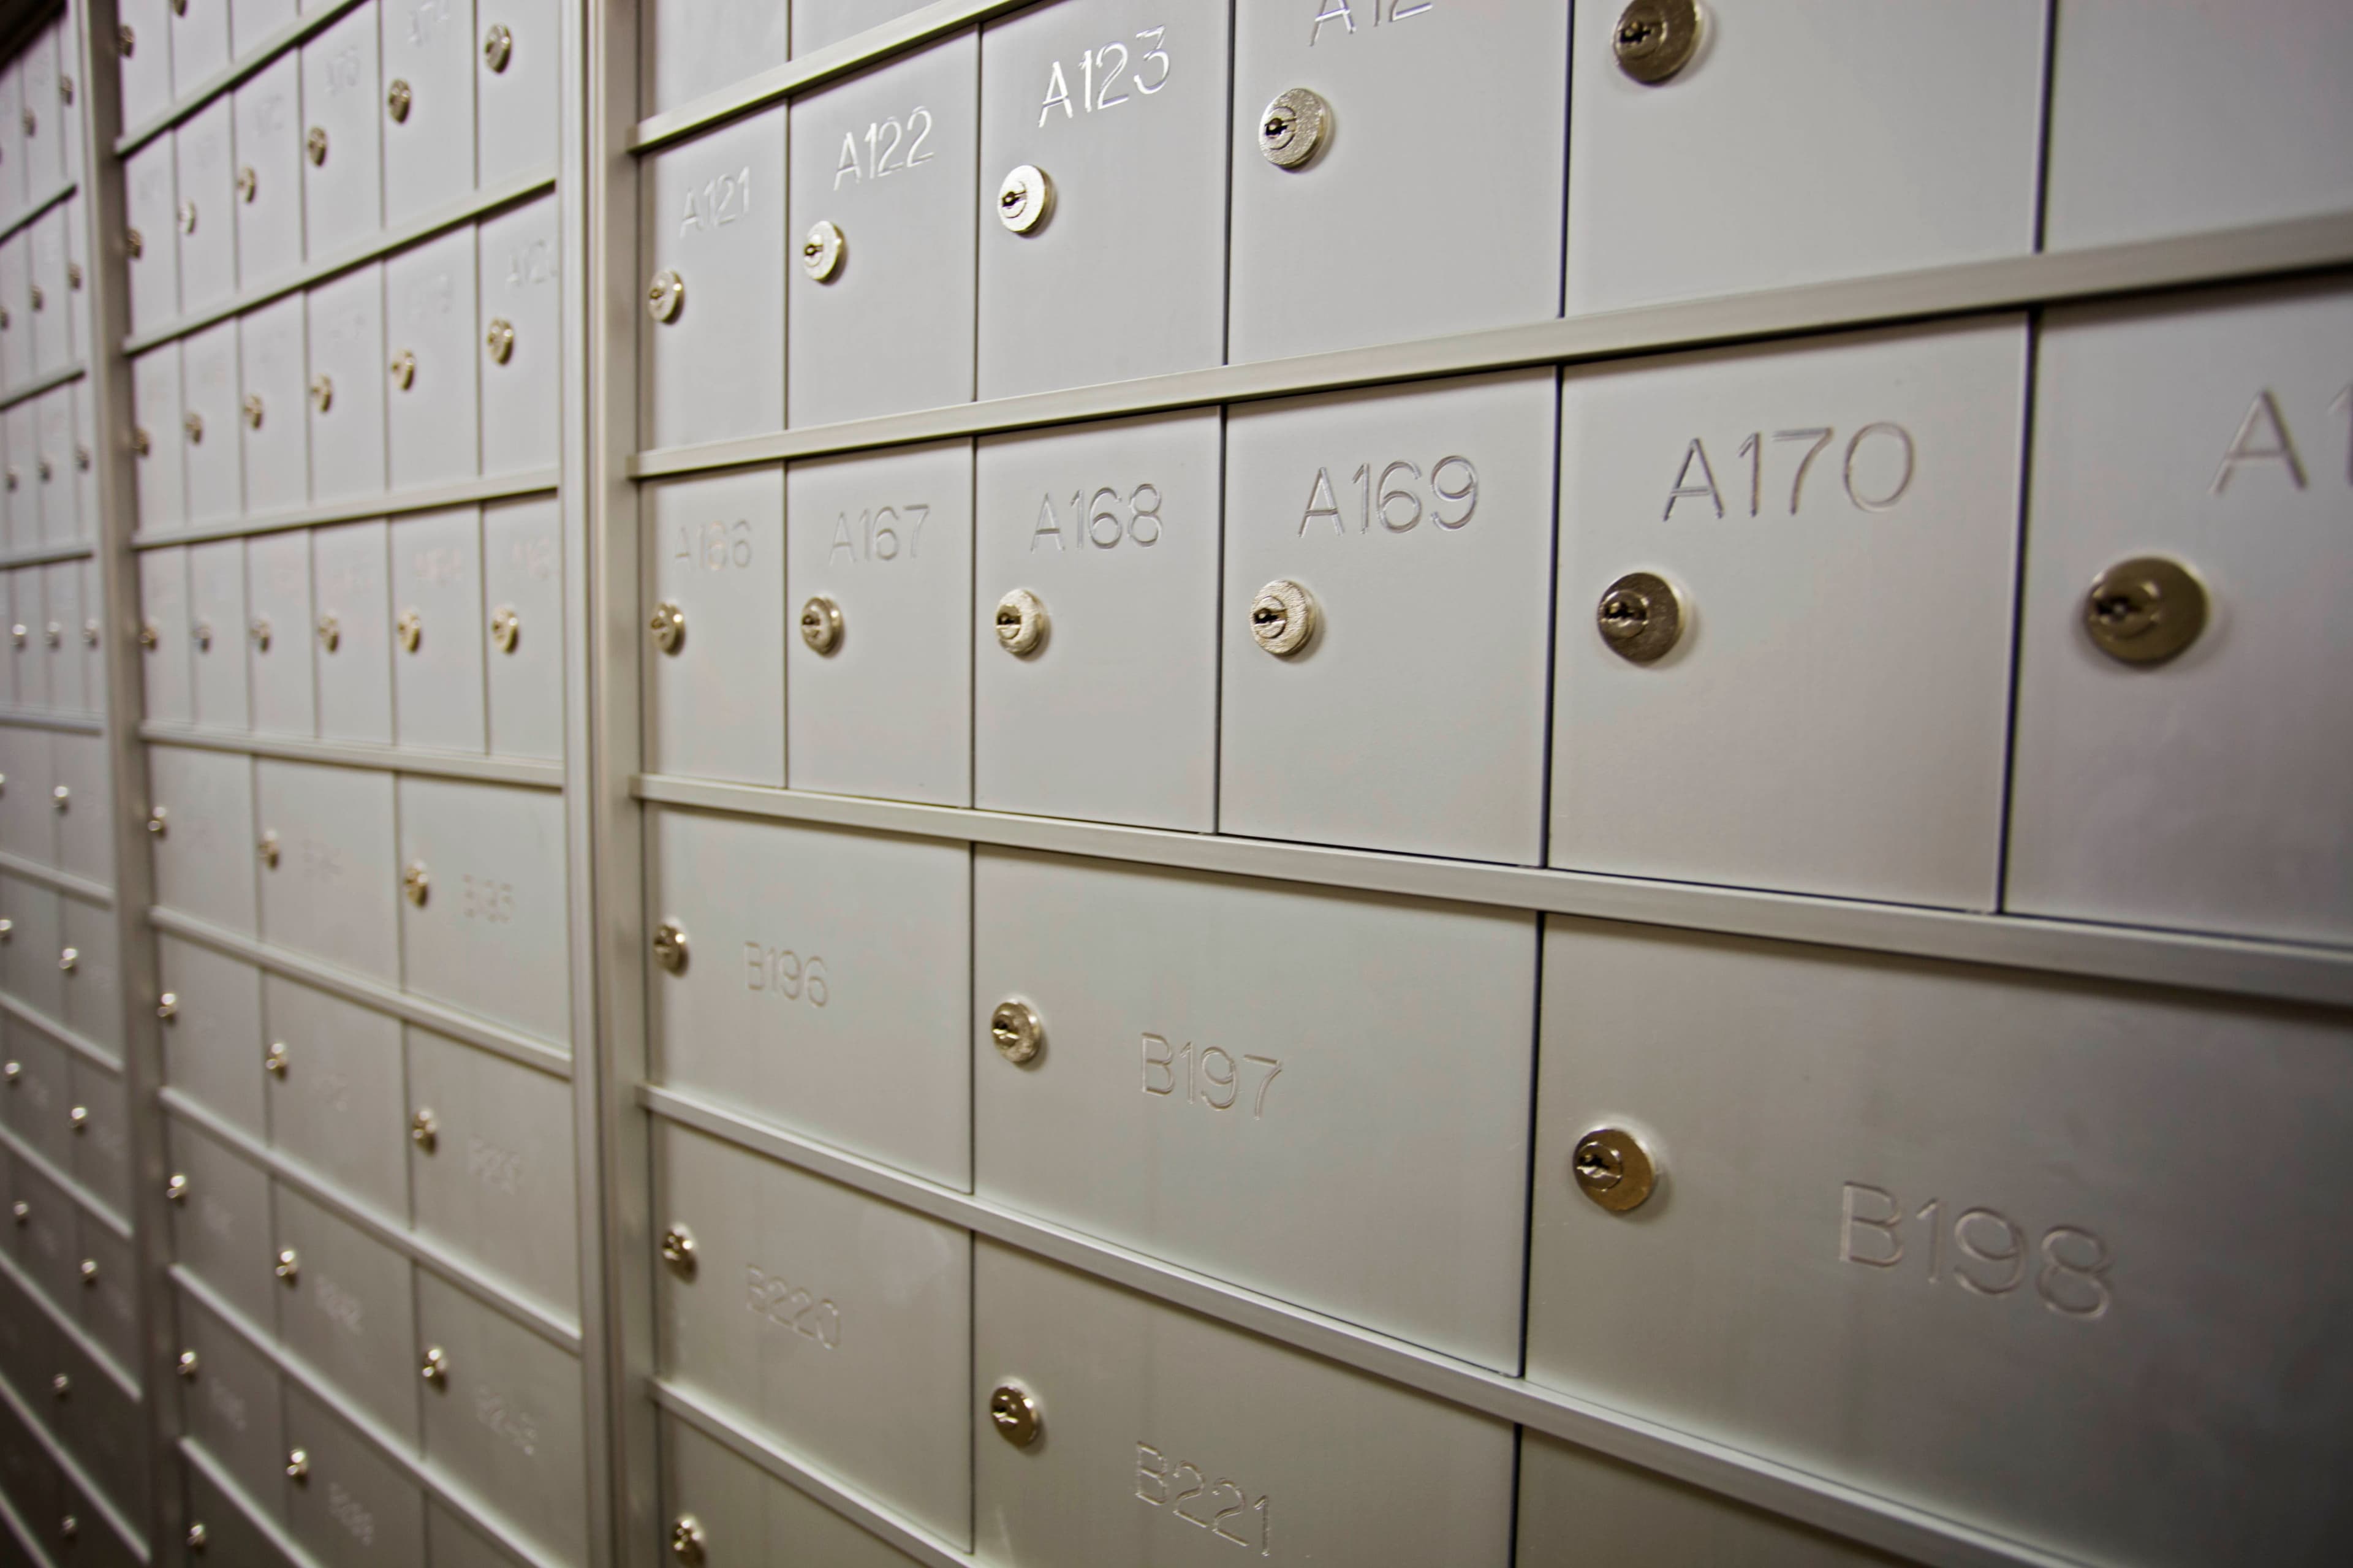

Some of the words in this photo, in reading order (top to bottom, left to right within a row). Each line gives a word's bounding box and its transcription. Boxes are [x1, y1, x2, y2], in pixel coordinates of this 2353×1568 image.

[1038, 25, 1171, 127] A123
[833, 105, 935, 191] A122
[680, 165, 751, 238] A121
[1297, 455, 1479, 539] A169
[1661, 421, 1915, 523] A170
[828, 504, 931, 569] A167
[1030, 483, 1163, 555] A168
[743, 939, 830, 1009] B196
[1138, 1031, 1284, 1122] B197
[1839, 1180, 2116, 1324] B198
[746, 1262, 843, 1350] B220
[1134, 1440, 1273, 1558] B221
